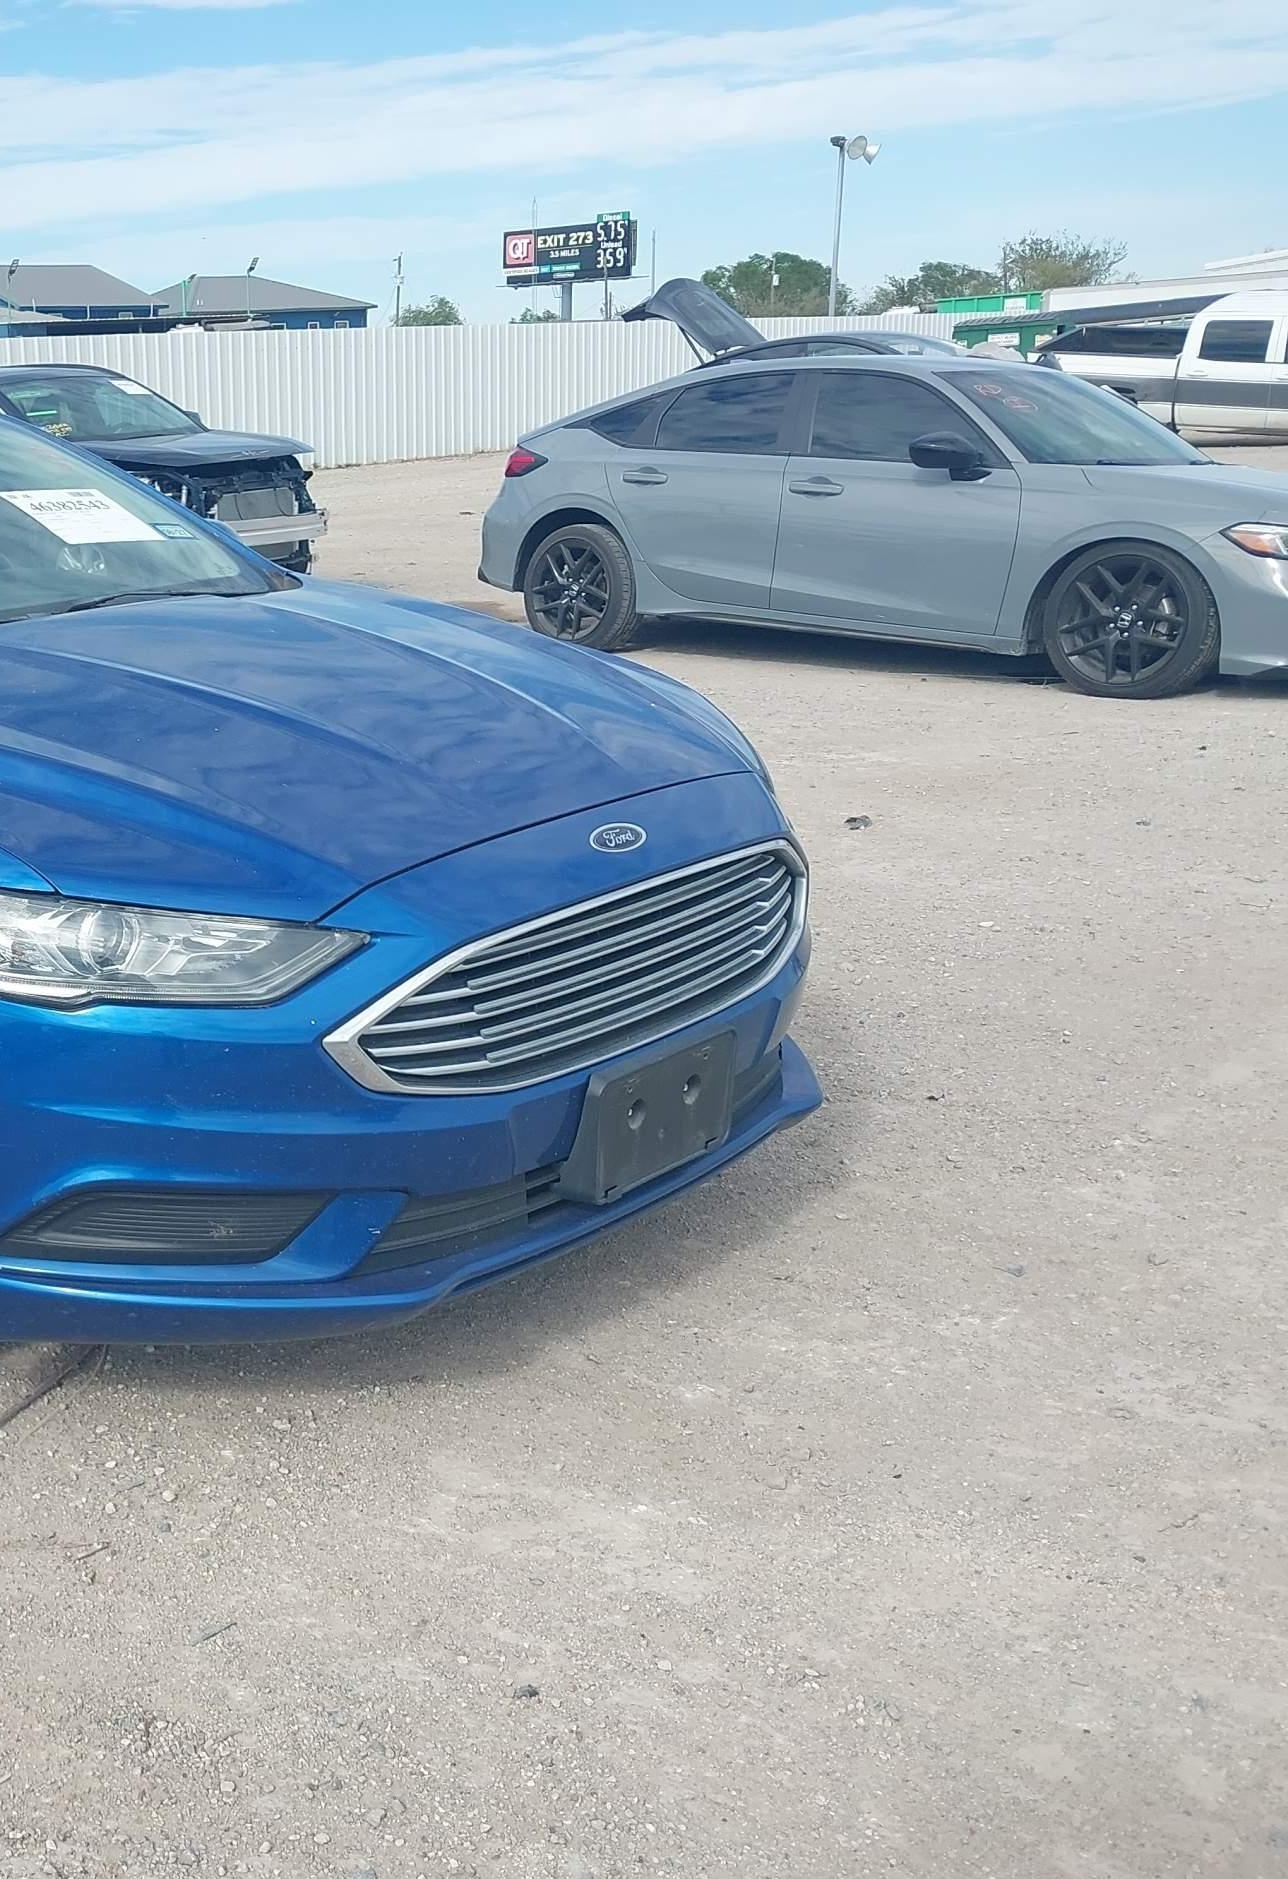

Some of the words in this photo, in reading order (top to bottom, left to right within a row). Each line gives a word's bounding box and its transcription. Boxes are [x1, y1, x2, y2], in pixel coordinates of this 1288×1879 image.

[508, 238, 531, 260] QT
[537, 234, 566, 249] EXIT
[568, 231, 593, 246] 273
[560, 249, 580, 258] MILES
[603, 829, 636, 847] Ford
